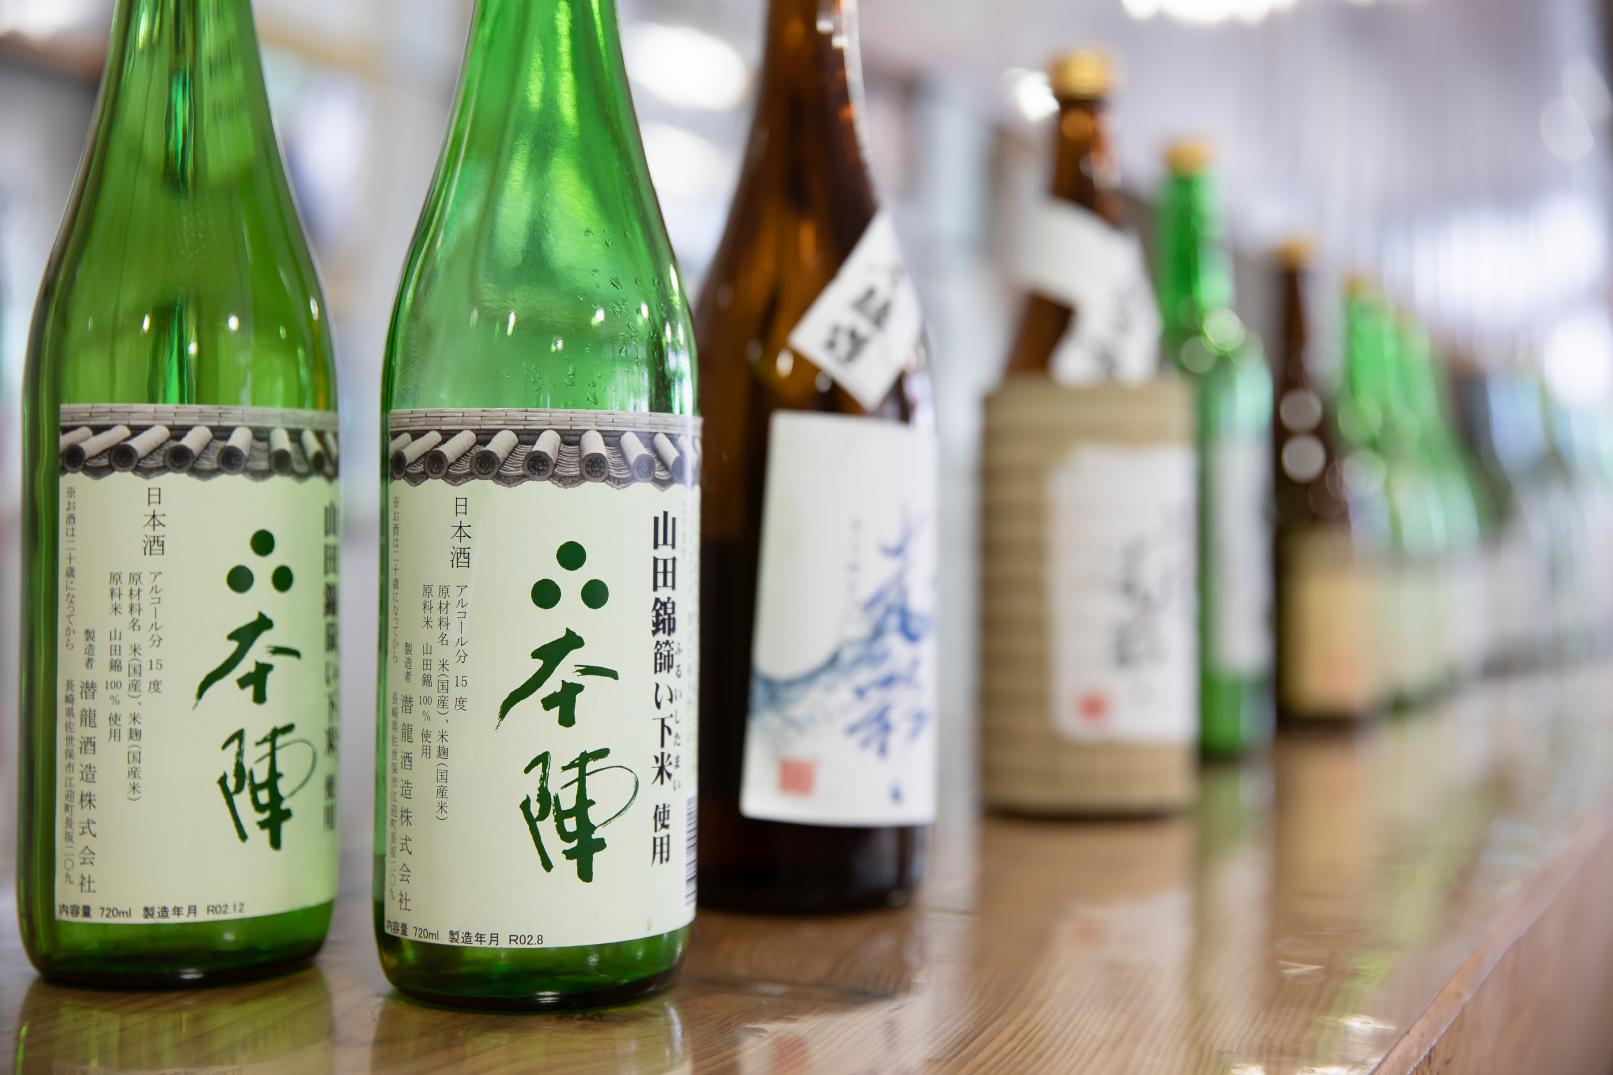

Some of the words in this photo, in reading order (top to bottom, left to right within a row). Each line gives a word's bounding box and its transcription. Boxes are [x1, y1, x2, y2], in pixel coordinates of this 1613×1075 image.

[142, 487, 166, 556] 日本酒
[450, 497, 472, 569] 日本酒
[109, 572, 123, 616] 原料米
[128, 572, 143, 632] 原材料名
[148, 571, 163, 648] アルコール分
[422, 585, 434, 629] 原料米
[437, 585, 450, 646] 原材料名
[455, 585, 469, 664] アルコール分
[84, 628, 95, 670] 製造者
[108, 628, 122, 672] 山田錦
[403, 642, 413, 683] 製造者
[421, 642, 433, 687] 山田錦
[651, 511, 677, 786] 山田錦篩い下米
[193, 610, 317, 850] 本陣
[495, 627, 639, 883] 本陣
[79, 680, 97, 893] 潜龍酒造株式会社
[398, 694, 414, 911] 潜龍酒造株式会社
[651, 803, 670, 866] 使用
[59, 904, 92, 918] 内容量
[99, 906, 132, 918] 720ml
[143, 904, 197, 920] 製造年月
[386, 920, 408, 936] 内容量
[413, 926, 439, 940] 720ml
[448, 930, 500, 946] 製造年月
[508, 934, 544, 946] R02.8
